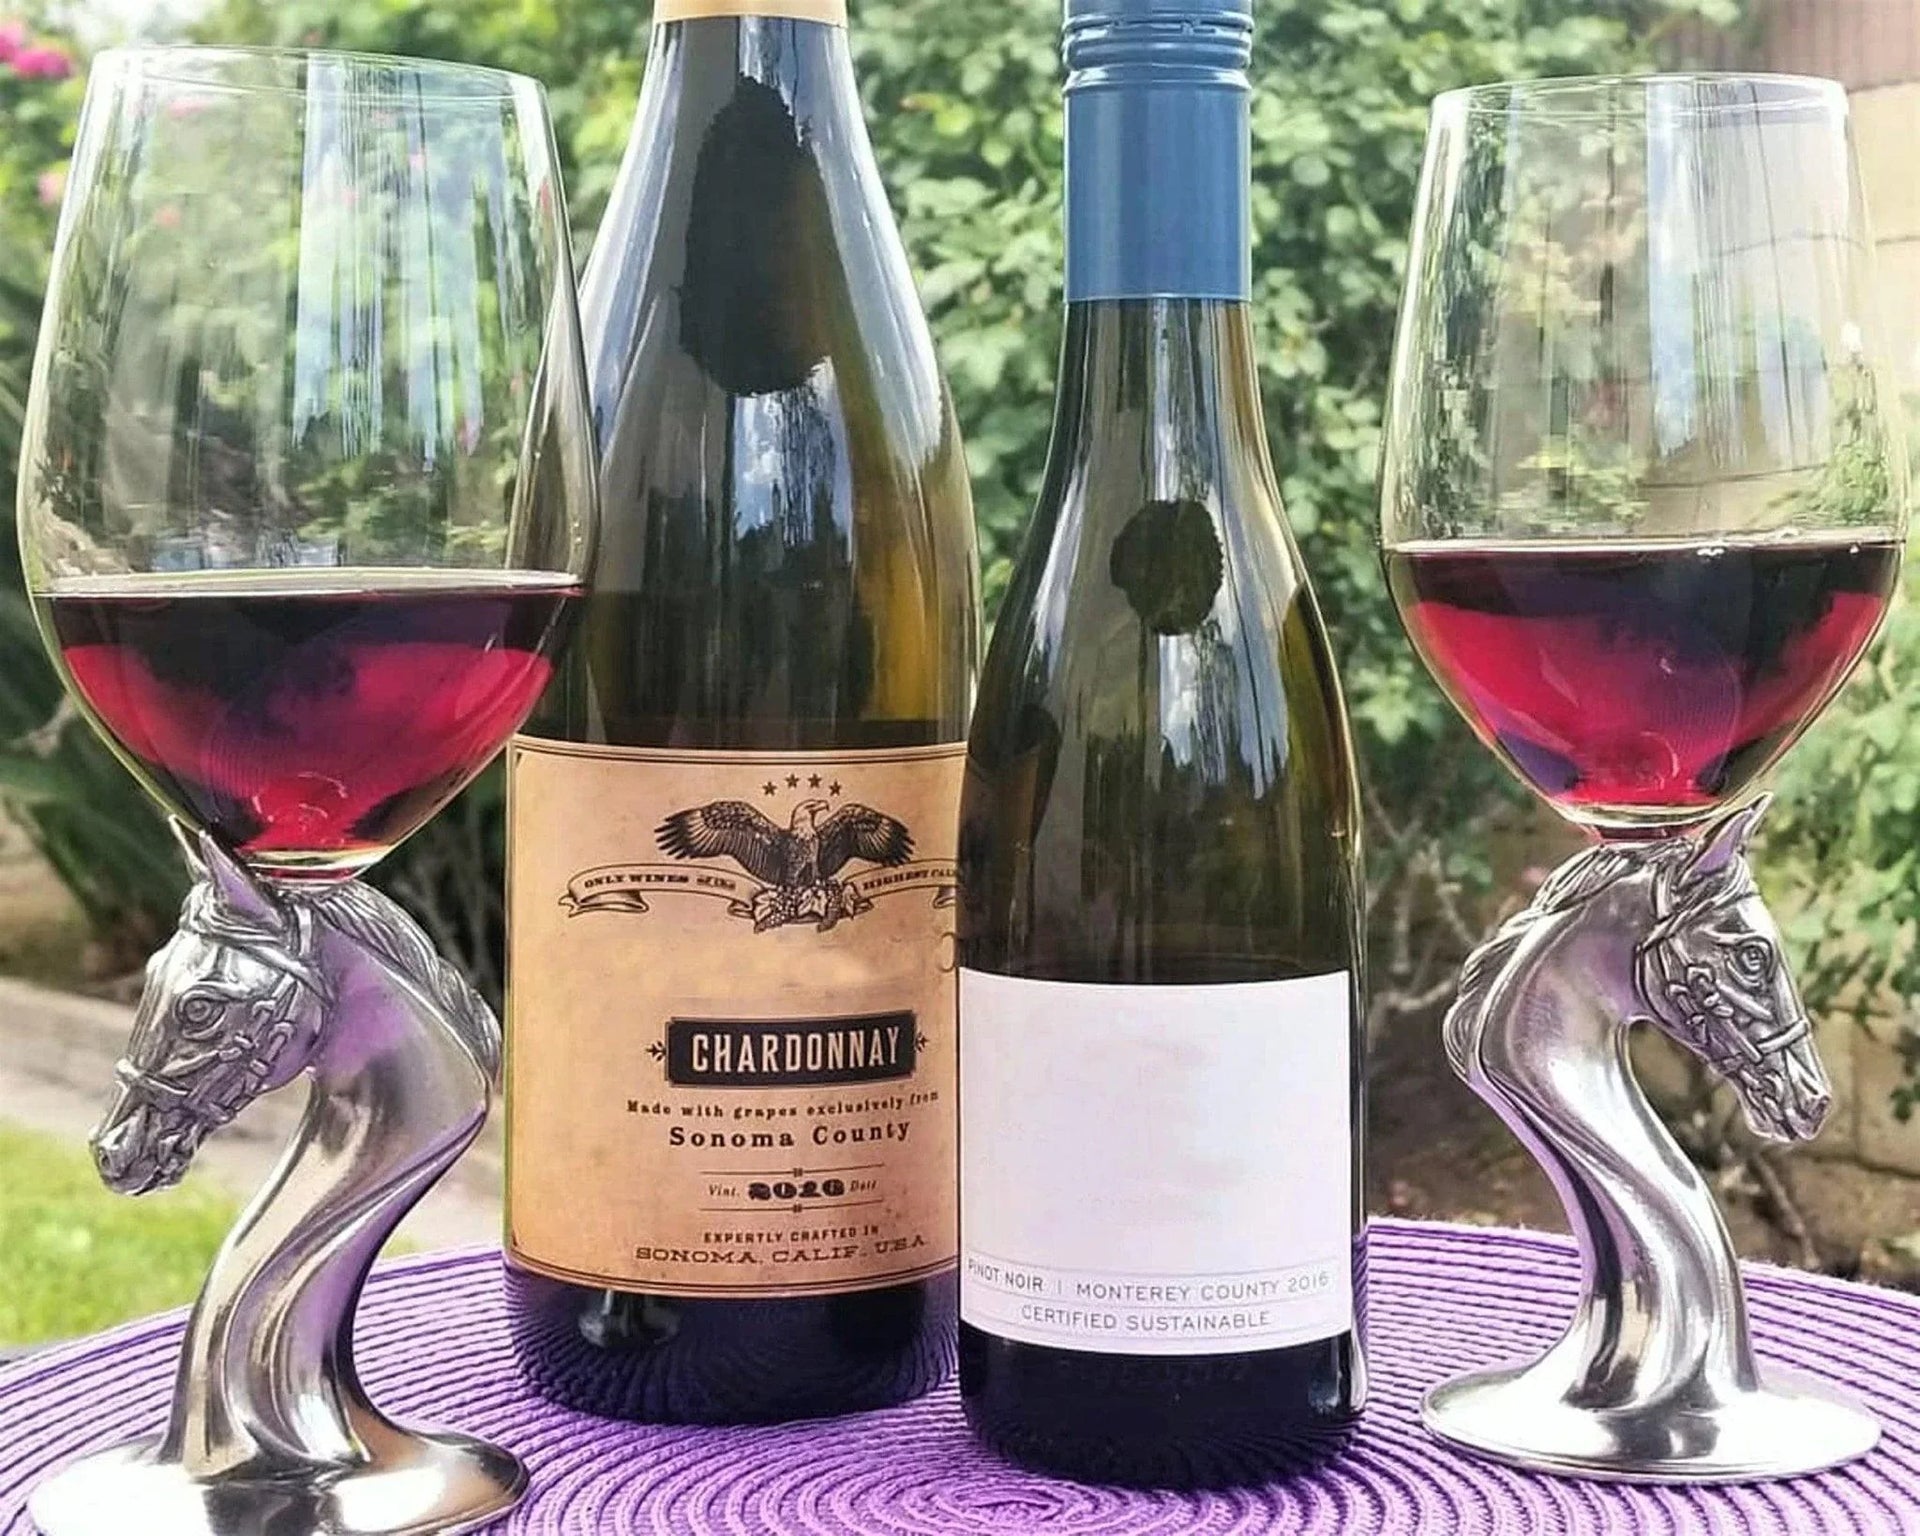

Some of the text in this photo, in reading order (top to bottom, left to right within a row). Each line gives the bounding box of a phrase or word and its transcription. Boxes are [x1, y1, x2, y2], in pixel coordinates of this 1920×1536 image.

[584, 874, 625, 889] ONLY
[629, 873, 689, 884] WINES
[691, 1026, 900, 1074] CHARDONNAY
[627, 1090, 939, 1120] Made with grapes exclusively from
[669, 1120, 911, 1148] Sonoma County
[704, 1224, 880, 1244] EXPERTLY CRAFTED IN
[967, 1257, 1329, 1301] PINOT NOIR MONTEREY COUNTY 2016
[1021, 1304, 1271, 1332] CERTIFIED SUSTAINABLE
